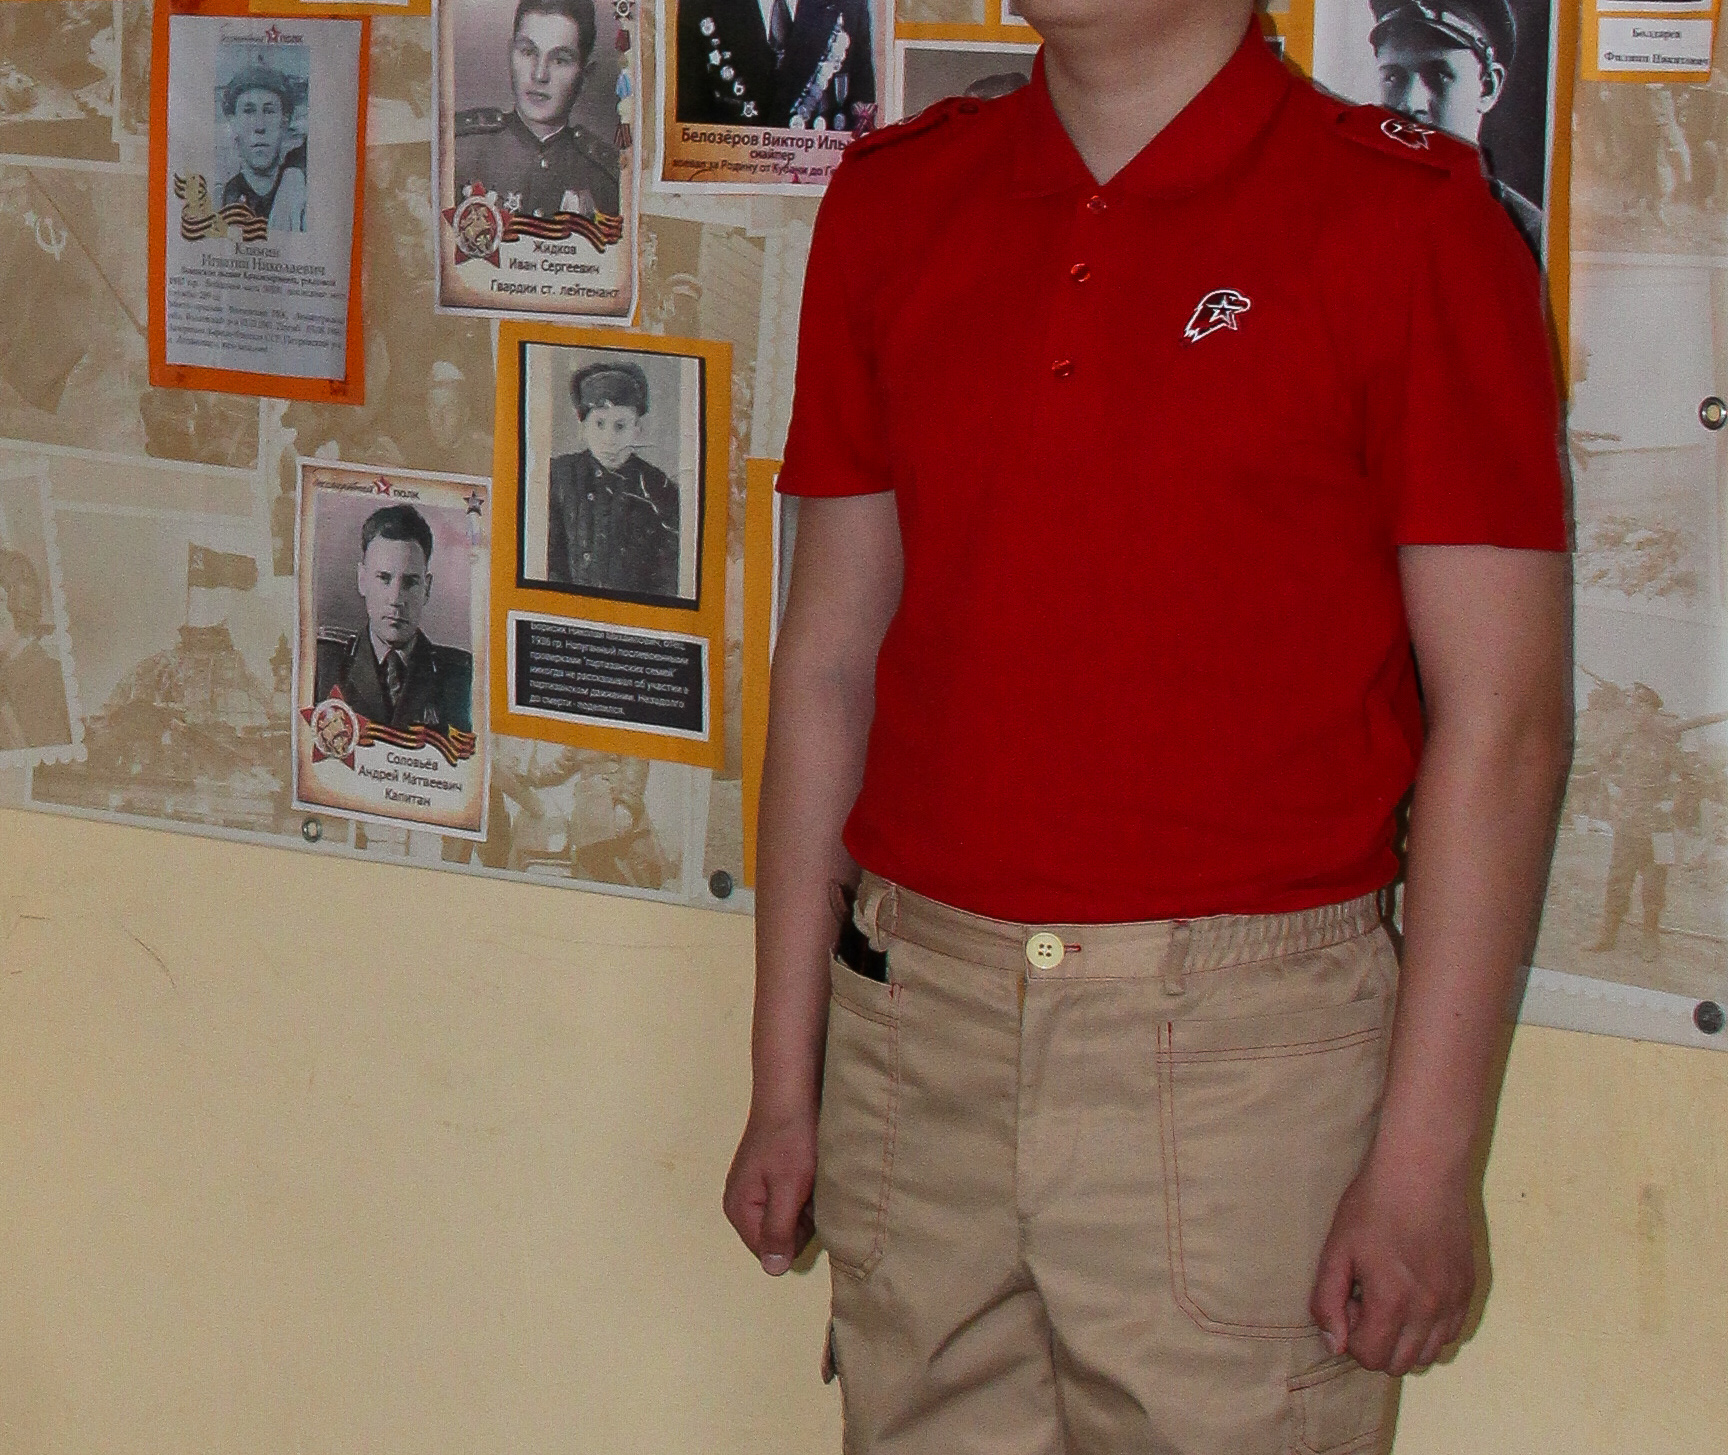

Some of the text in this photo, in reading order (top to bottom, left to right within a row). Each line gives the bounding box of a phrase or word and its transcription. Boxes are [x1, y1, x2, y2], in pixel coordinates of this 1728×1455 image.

[681, 127, 759, 147] Белозёров
[761, 131, 815, 149] Виктор
[721, 160, 759, 175] Родину
[532, 240, 577, 255] Жидков
[509, 258, 600, 276] Иван Сергеевич
[491, 279, 620, 299] Гвардии ст. лейтенант
[387, 751, 438, 771] Соловьёв
[358, 764, 462, 792] Андрей Матвеевич
[385, 787, 431, 806] Капитан
